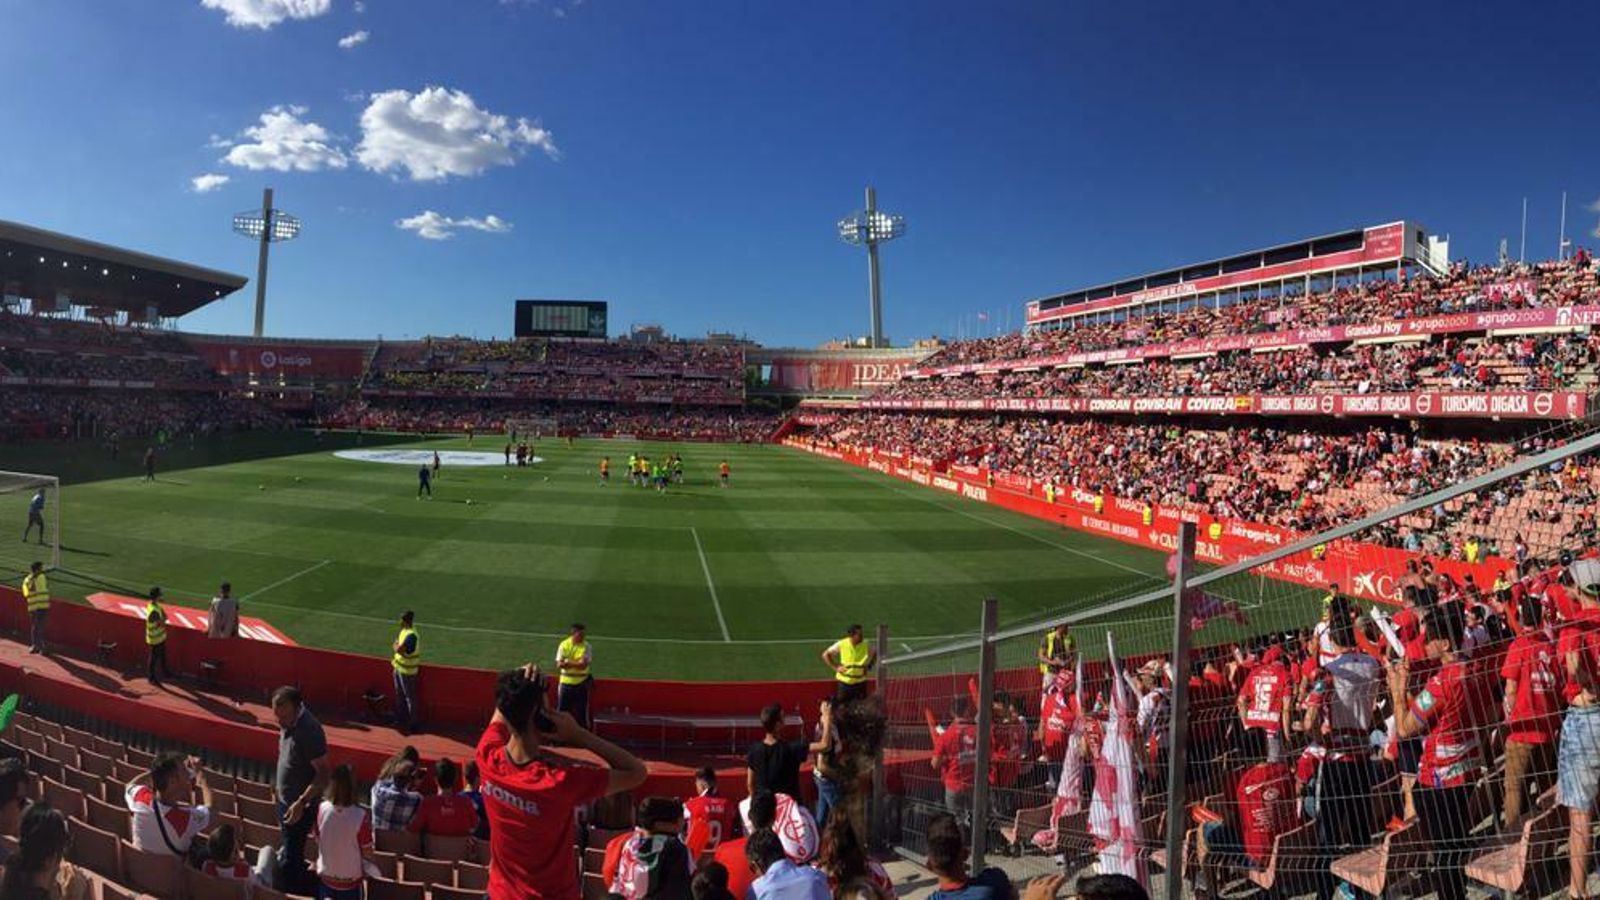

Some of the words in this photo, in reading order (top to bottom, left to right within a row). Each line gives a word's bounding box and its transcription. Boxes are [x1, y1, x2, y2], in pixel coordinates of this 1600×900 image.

[1416, 316, 1469, 331] grupo2000
[1485, 310, 1545, 326] grupo2000
[1441, 395, 1489, 413] TURISMOS
[1490, 395, 1528, 413] DIGASA
